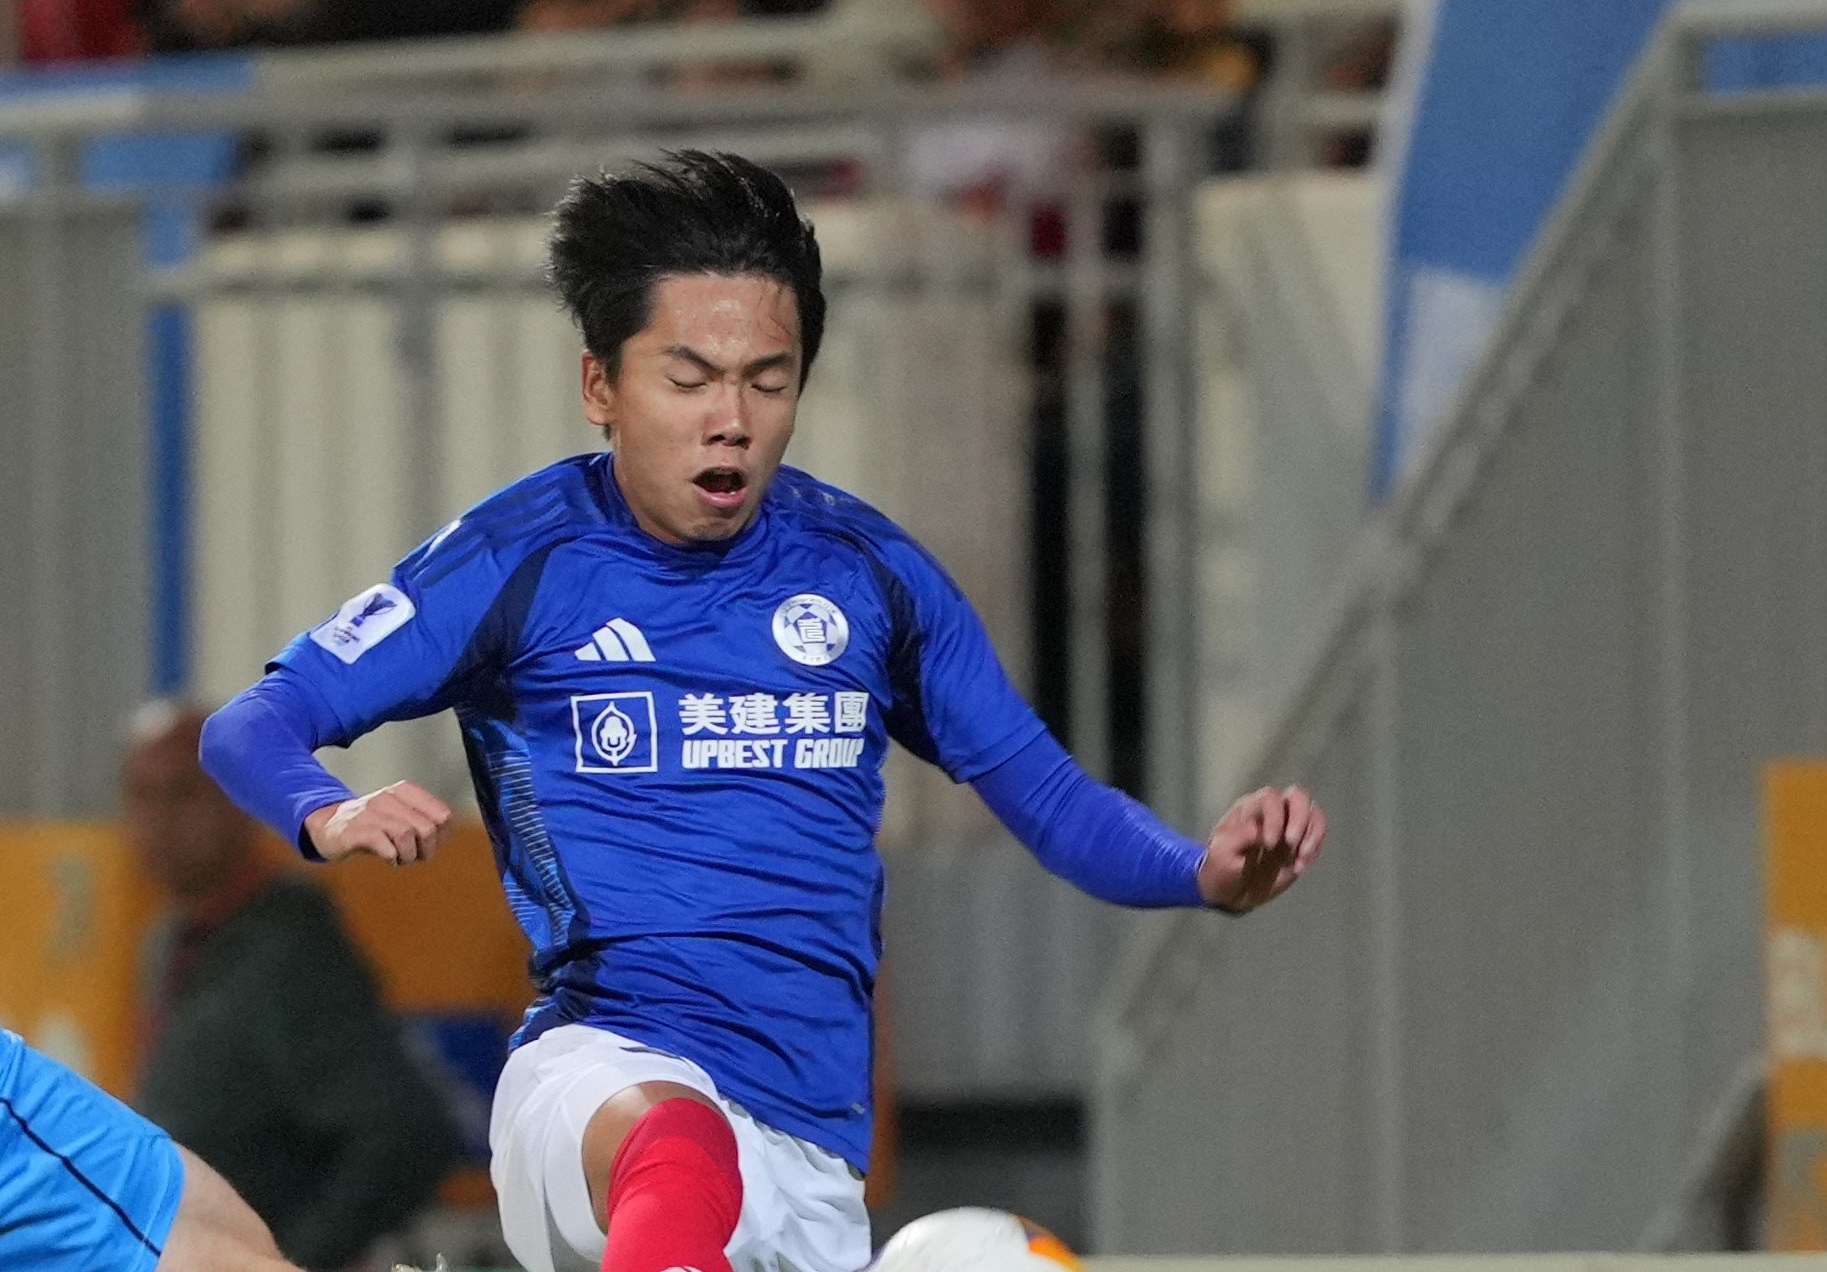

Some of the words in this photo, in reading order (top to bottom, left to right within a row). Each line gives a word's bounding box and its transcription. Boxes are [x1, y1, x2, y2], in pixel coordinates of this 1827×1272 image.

[678, 690, 870, 736] 美建集團
[682, 738, 789, 769] UPBEST
[794, 737, 865, 769] GROUP
